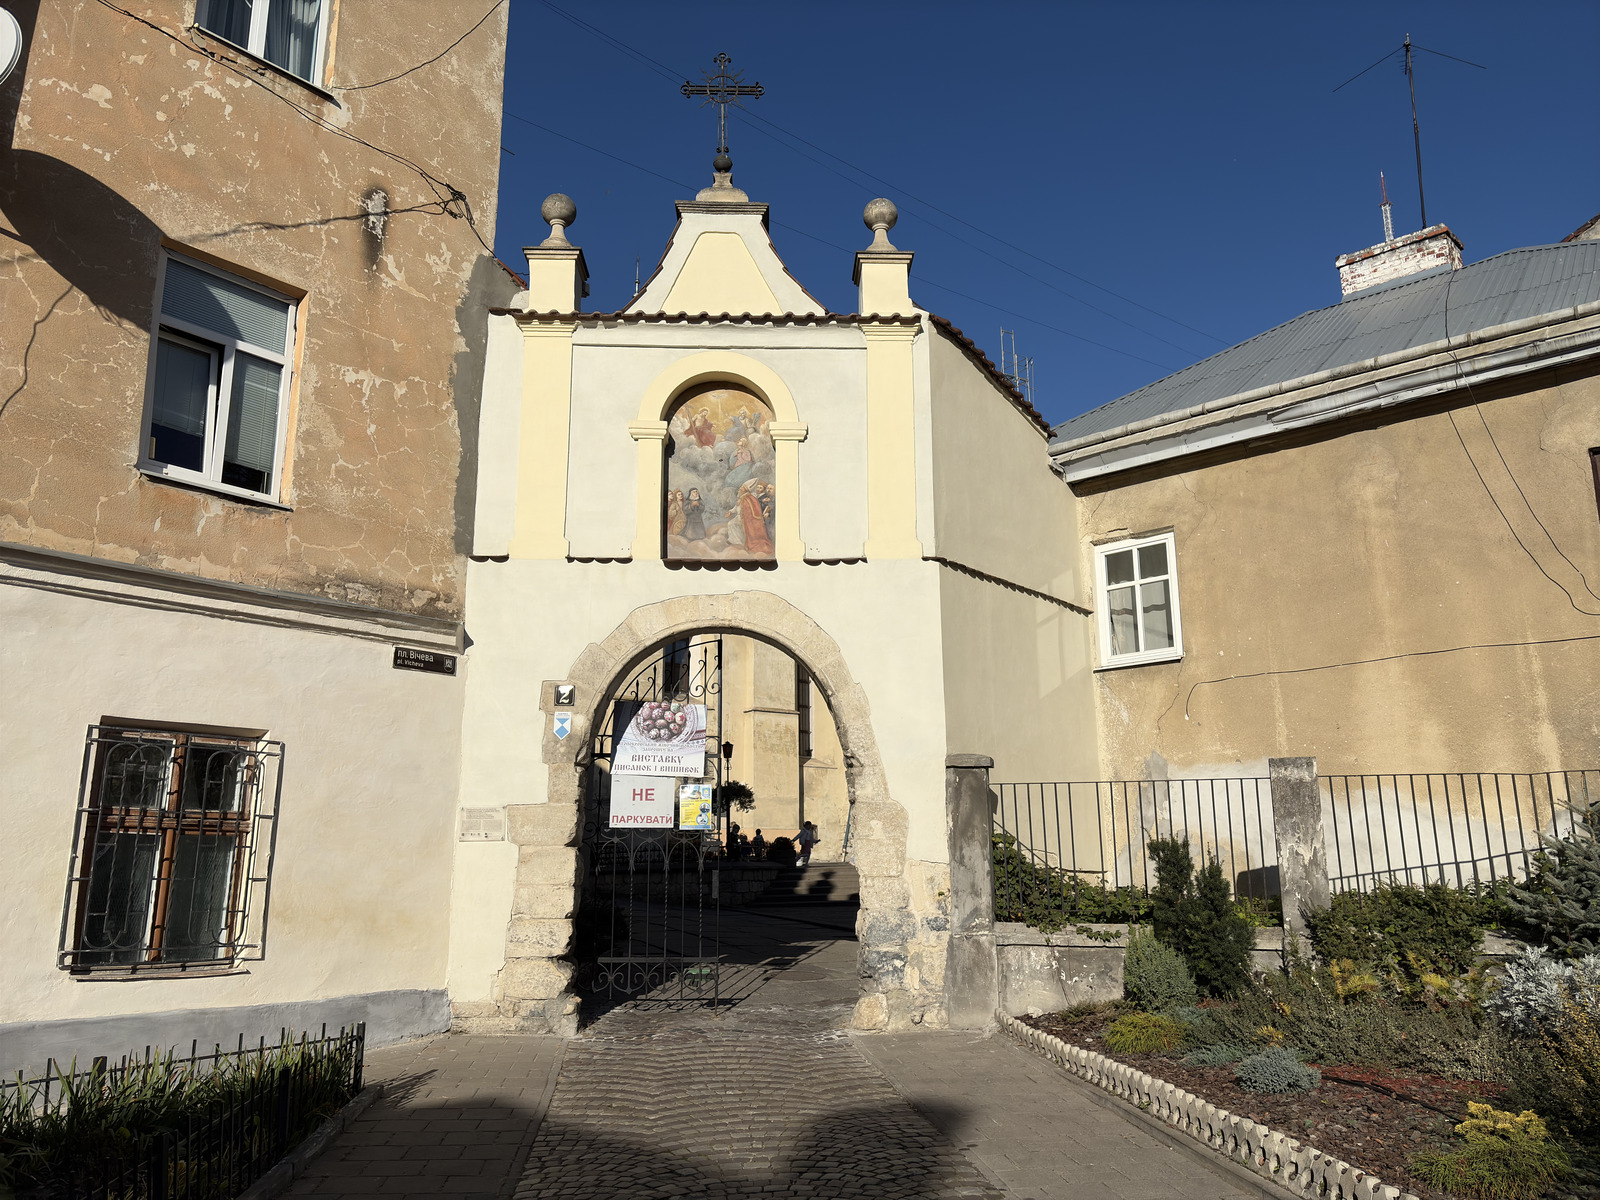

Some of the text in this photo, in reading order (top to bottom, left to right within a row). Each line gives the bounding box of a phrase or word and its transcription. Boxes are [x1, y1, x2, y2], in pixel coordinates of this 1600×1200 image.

[410, 651, 434, 662] Вічева
[632, 754, 684, 765] ВИСТАВКУ
[632, 788, 655, 802] НЕ
[611, 815, 673, 824] ПАРКУВАТИ
